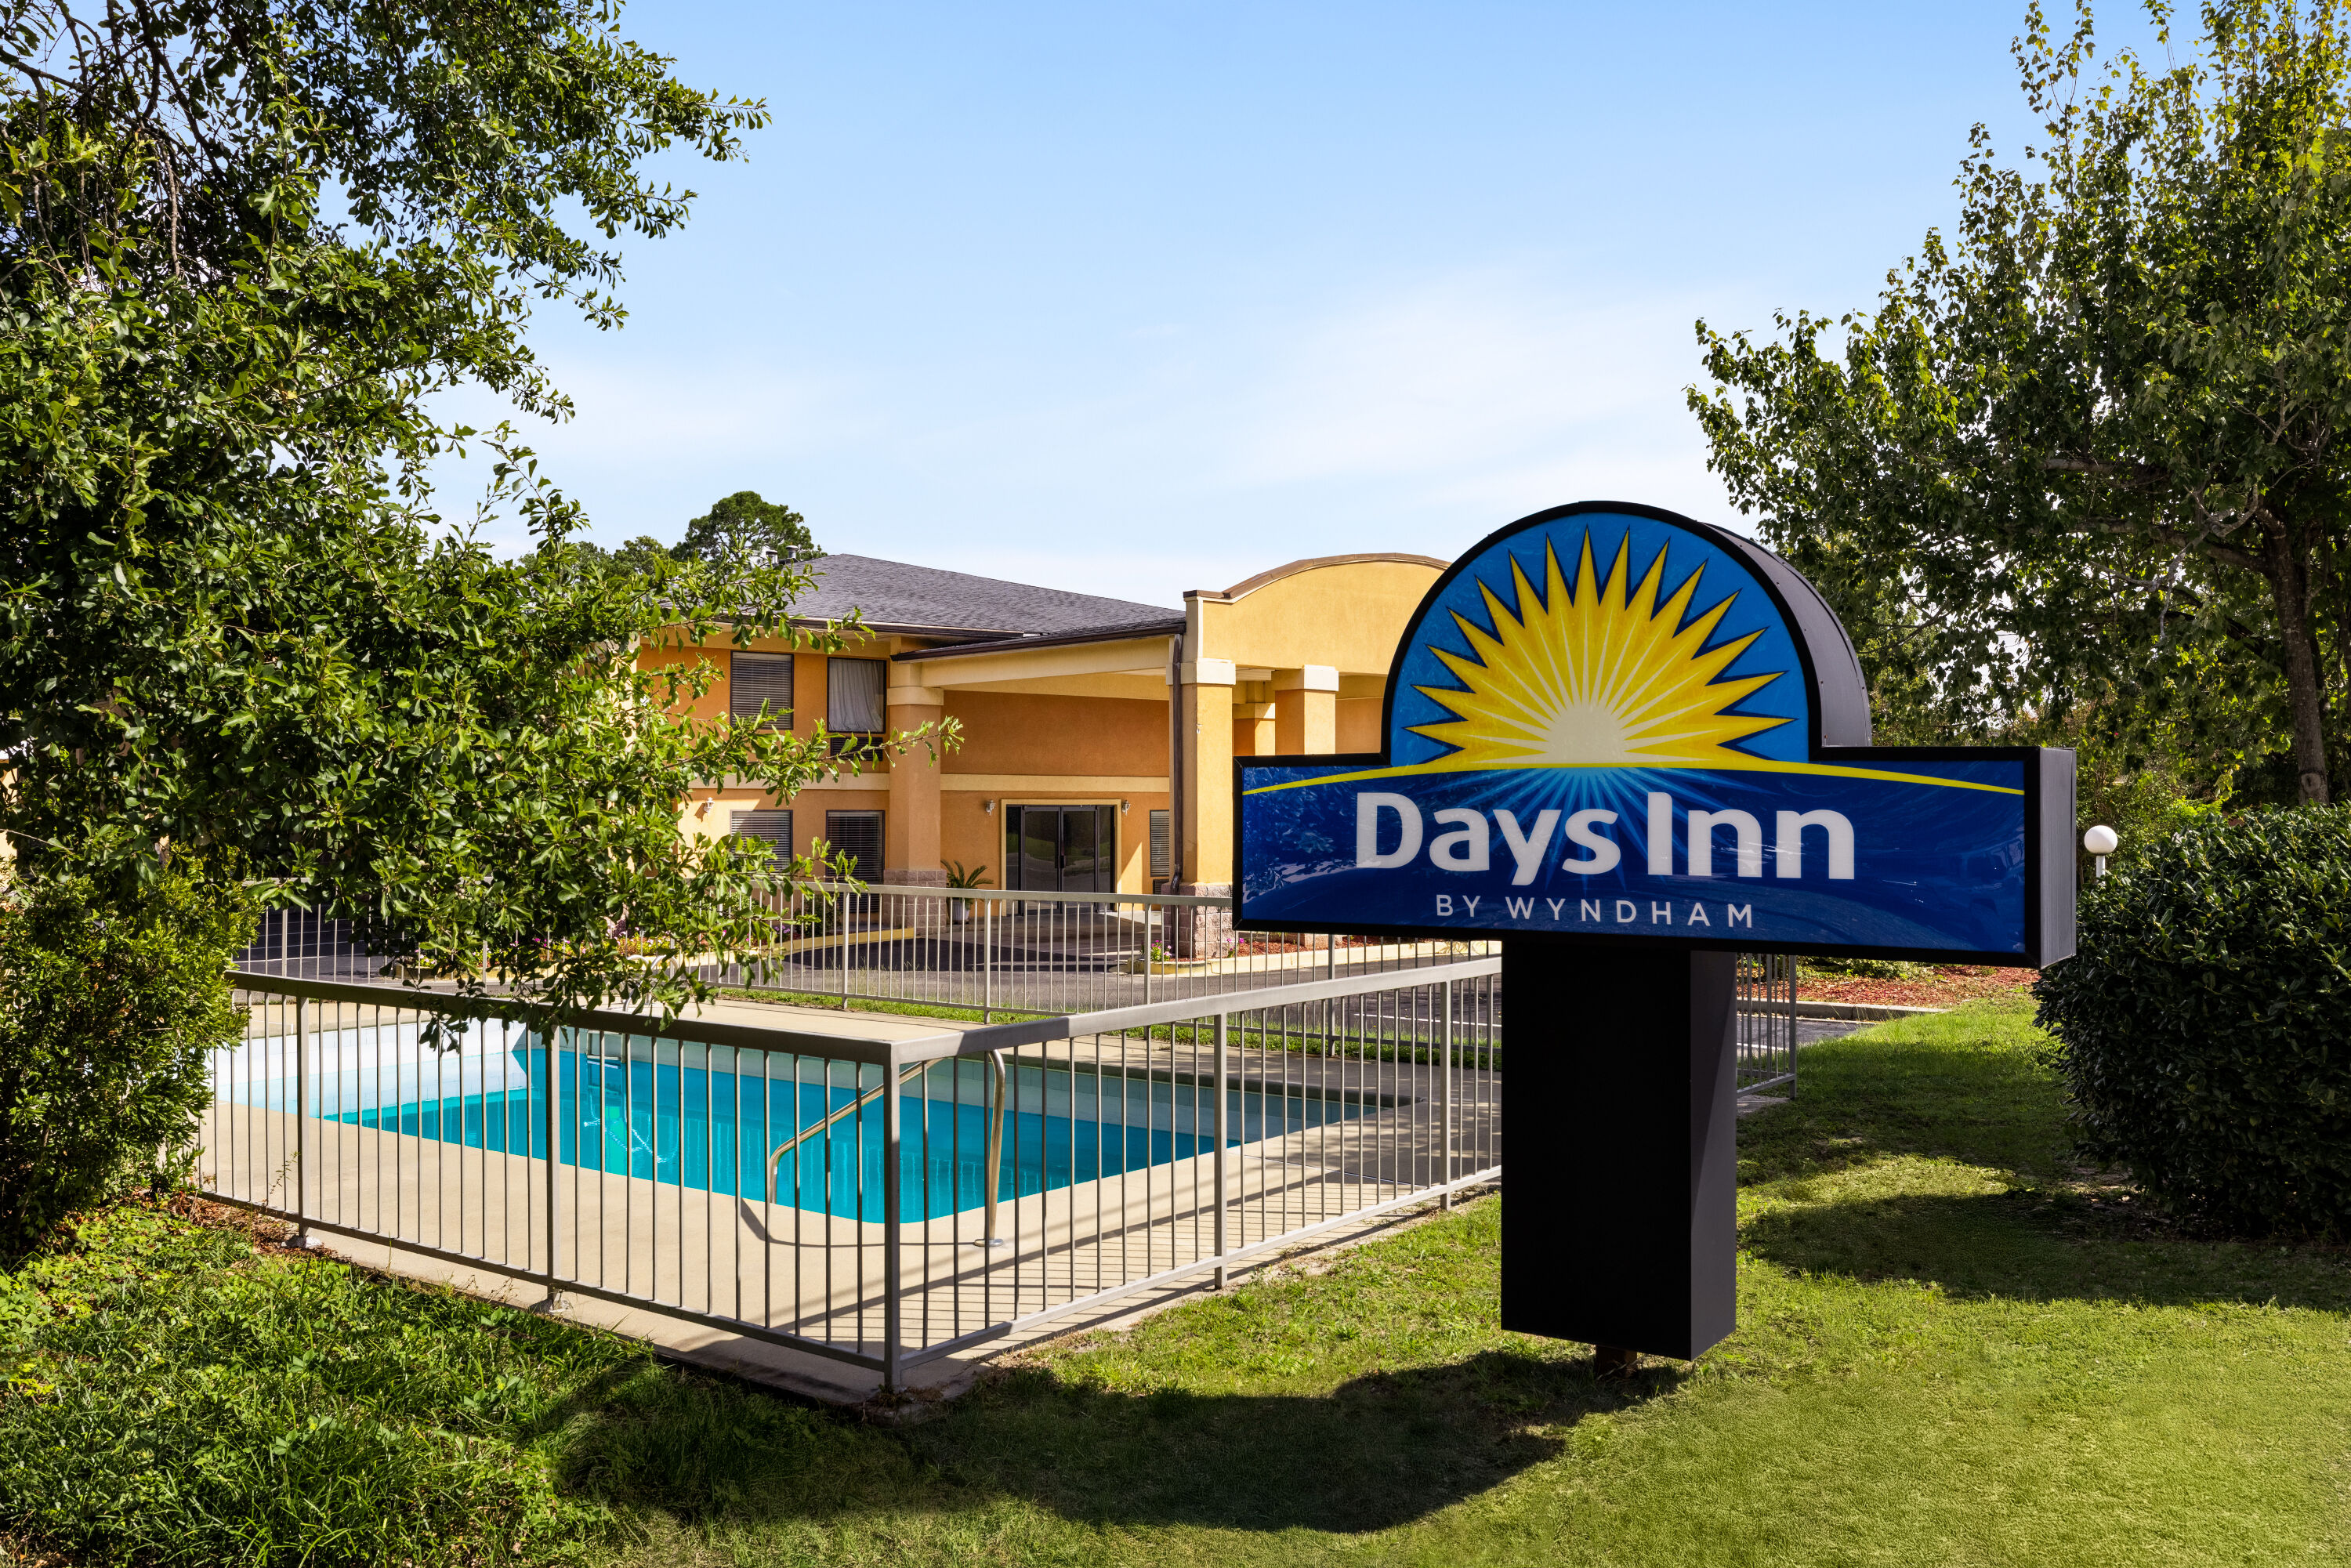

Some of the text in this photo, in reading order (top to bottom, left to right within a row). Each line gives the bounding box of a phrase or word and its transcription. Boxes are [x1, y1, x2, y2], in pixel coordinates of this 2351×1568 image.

[1356, 791, 1855, 886] Days Inn
[1436, 894, 1752, 929] BY WYNDHAM
